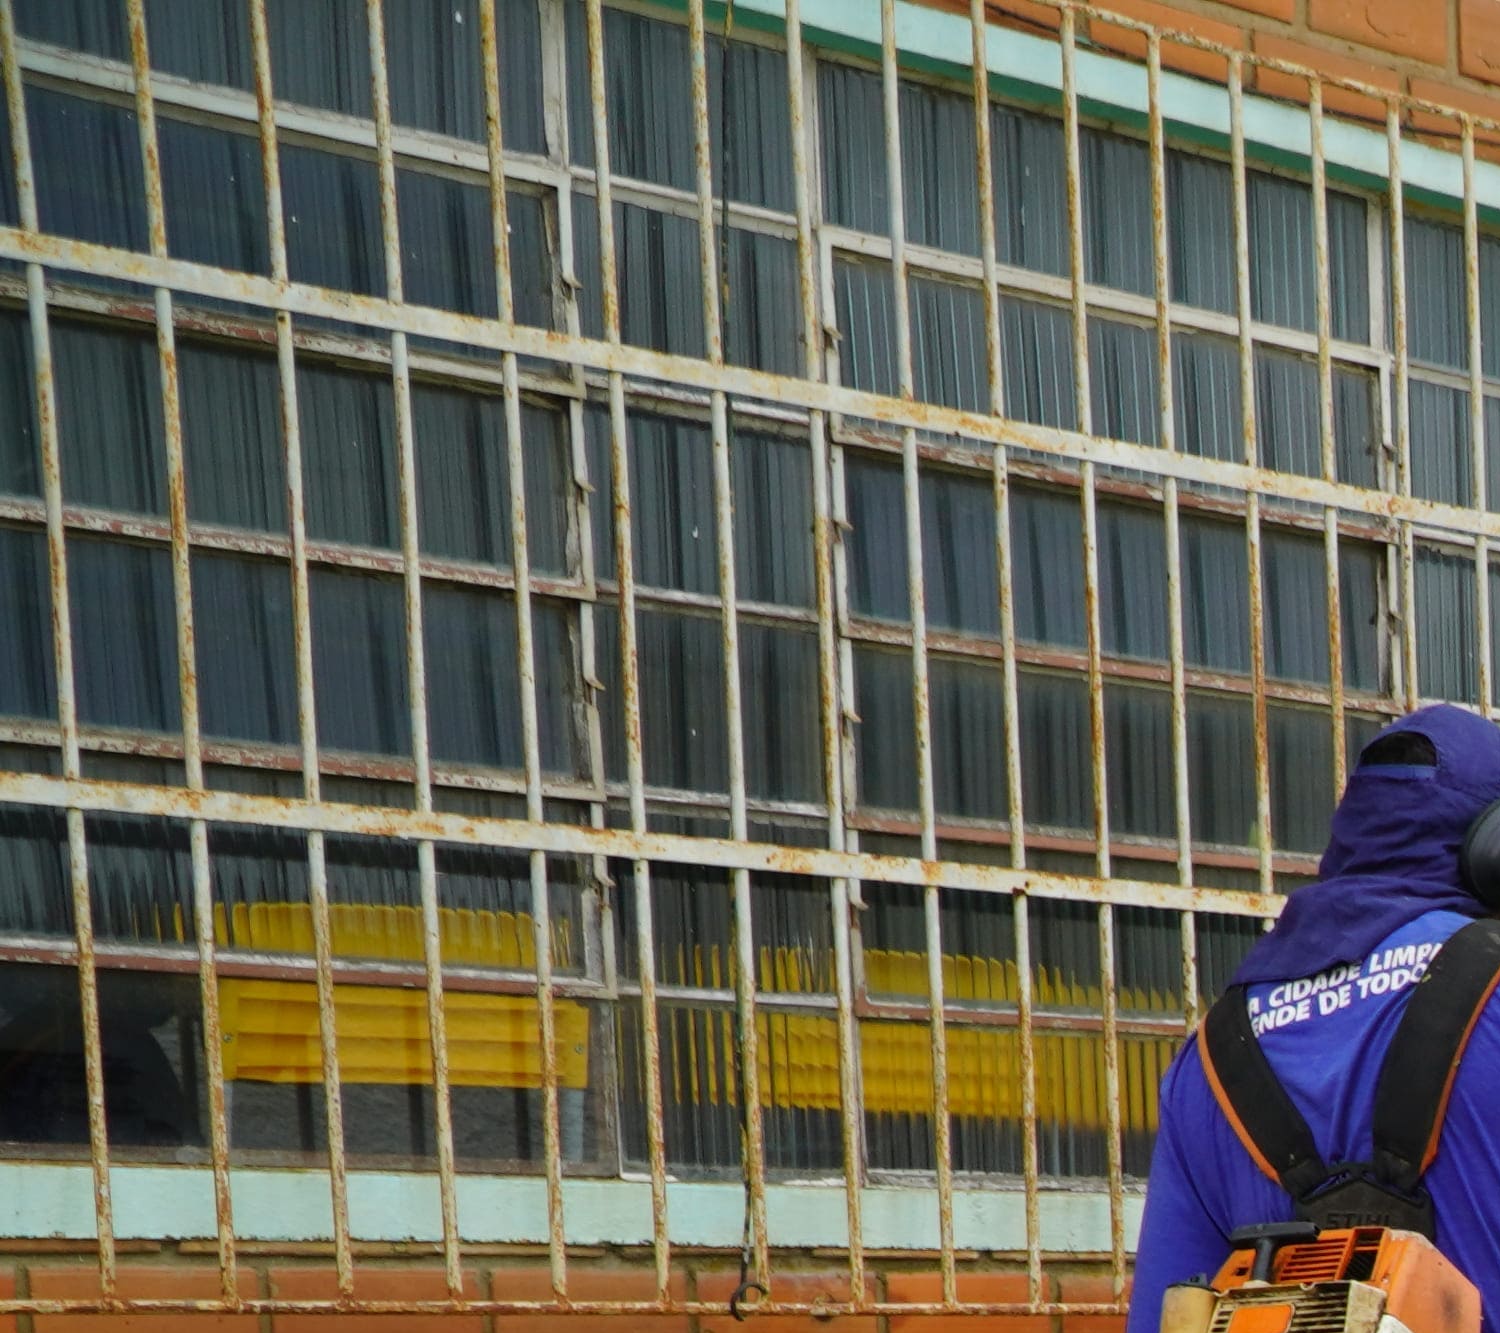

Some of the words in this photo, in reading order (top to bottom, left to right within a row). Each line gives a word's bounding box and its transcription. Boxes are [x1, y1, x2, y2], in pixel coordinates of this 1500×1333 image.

[1250, 998, 1312, 1039] ENDE
[1318, 984, 1352, 1016] DE
[1357, 963, 1428, 999] TODO
[1268, 964, 1362, 1008] CIDADE
